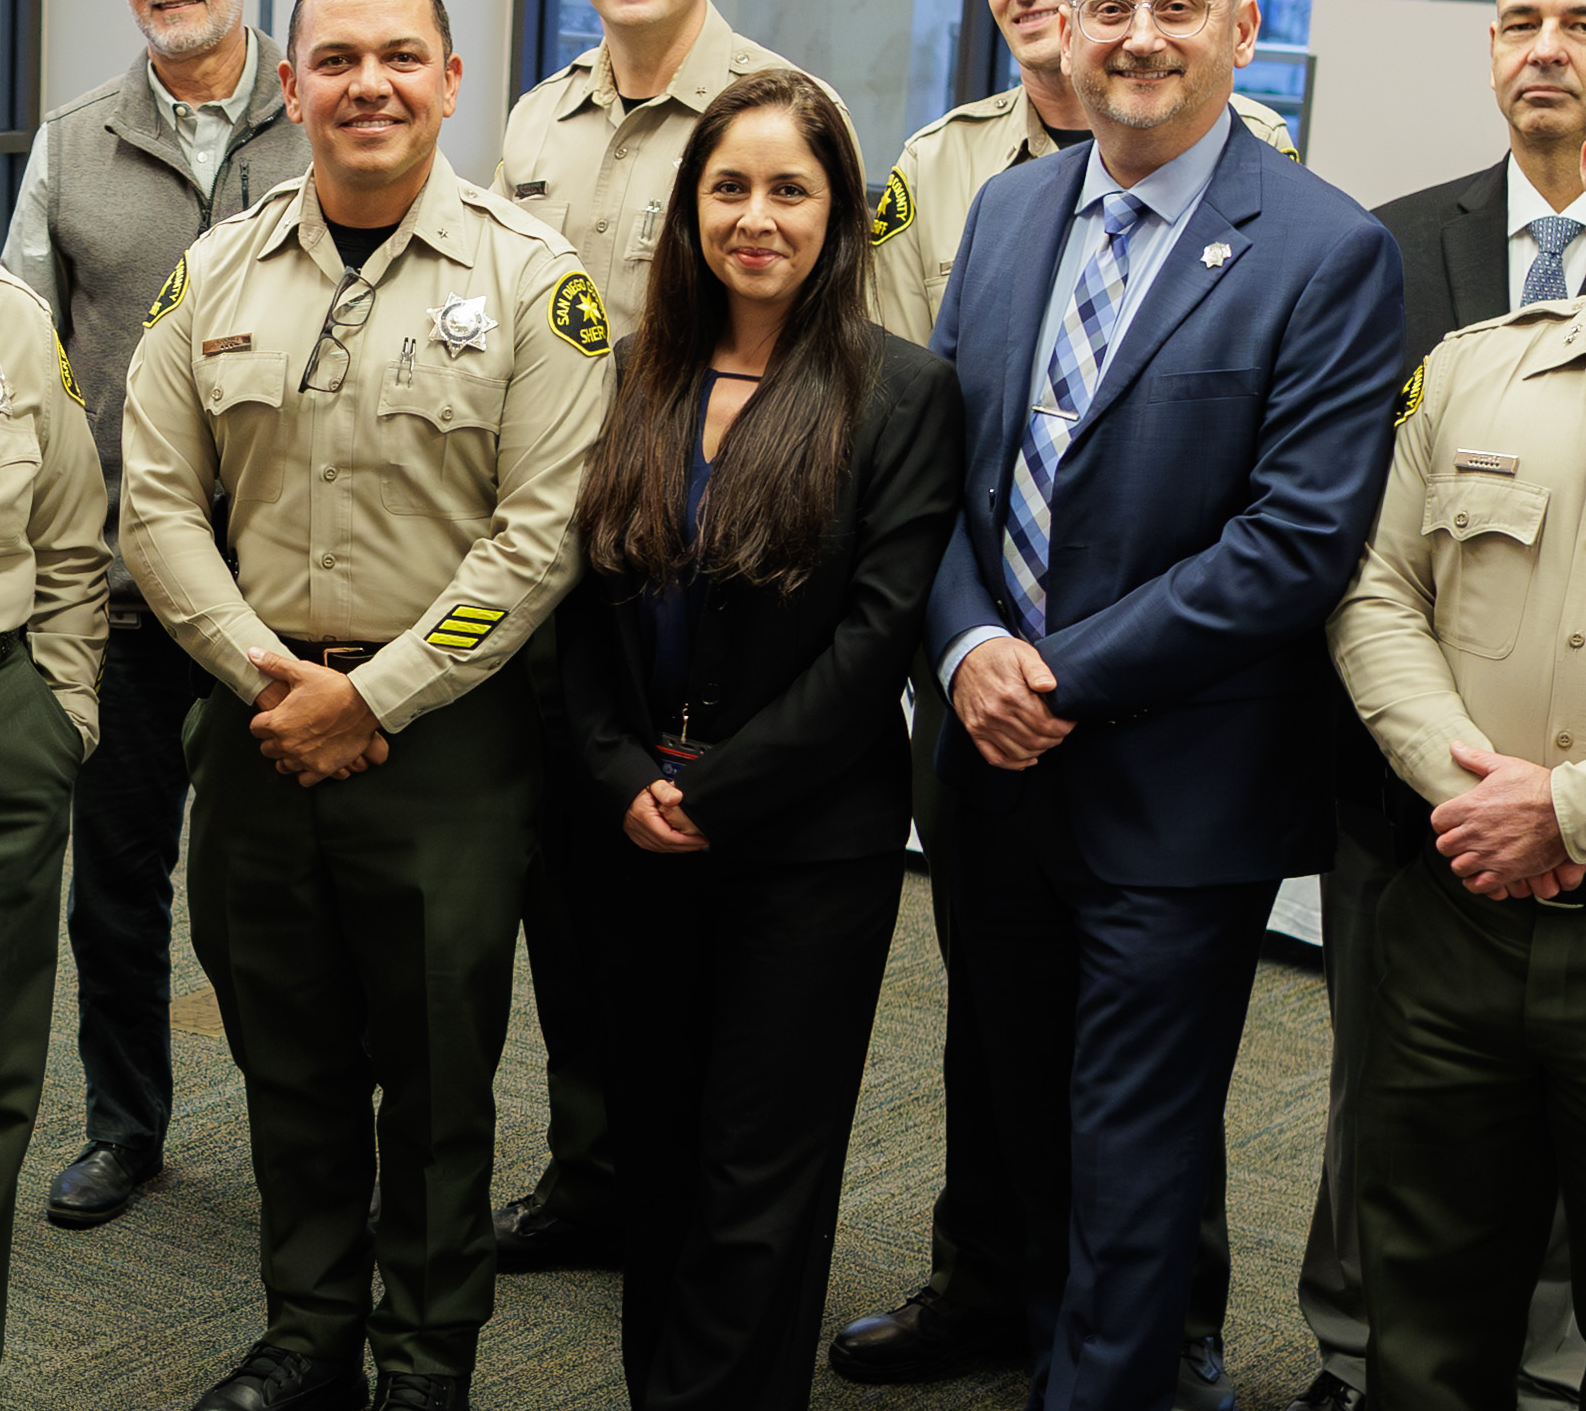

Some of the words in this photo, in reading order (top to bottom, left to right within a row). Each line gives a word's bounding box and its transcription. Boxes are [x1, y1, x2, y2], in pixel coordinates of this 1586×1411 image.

[892, 177, 908, 222] COUNTY
[562, 278, 587, 300] DIEGO
[557, 298, 571, 326] SAN
[580, 325, 607, 344] SHER
